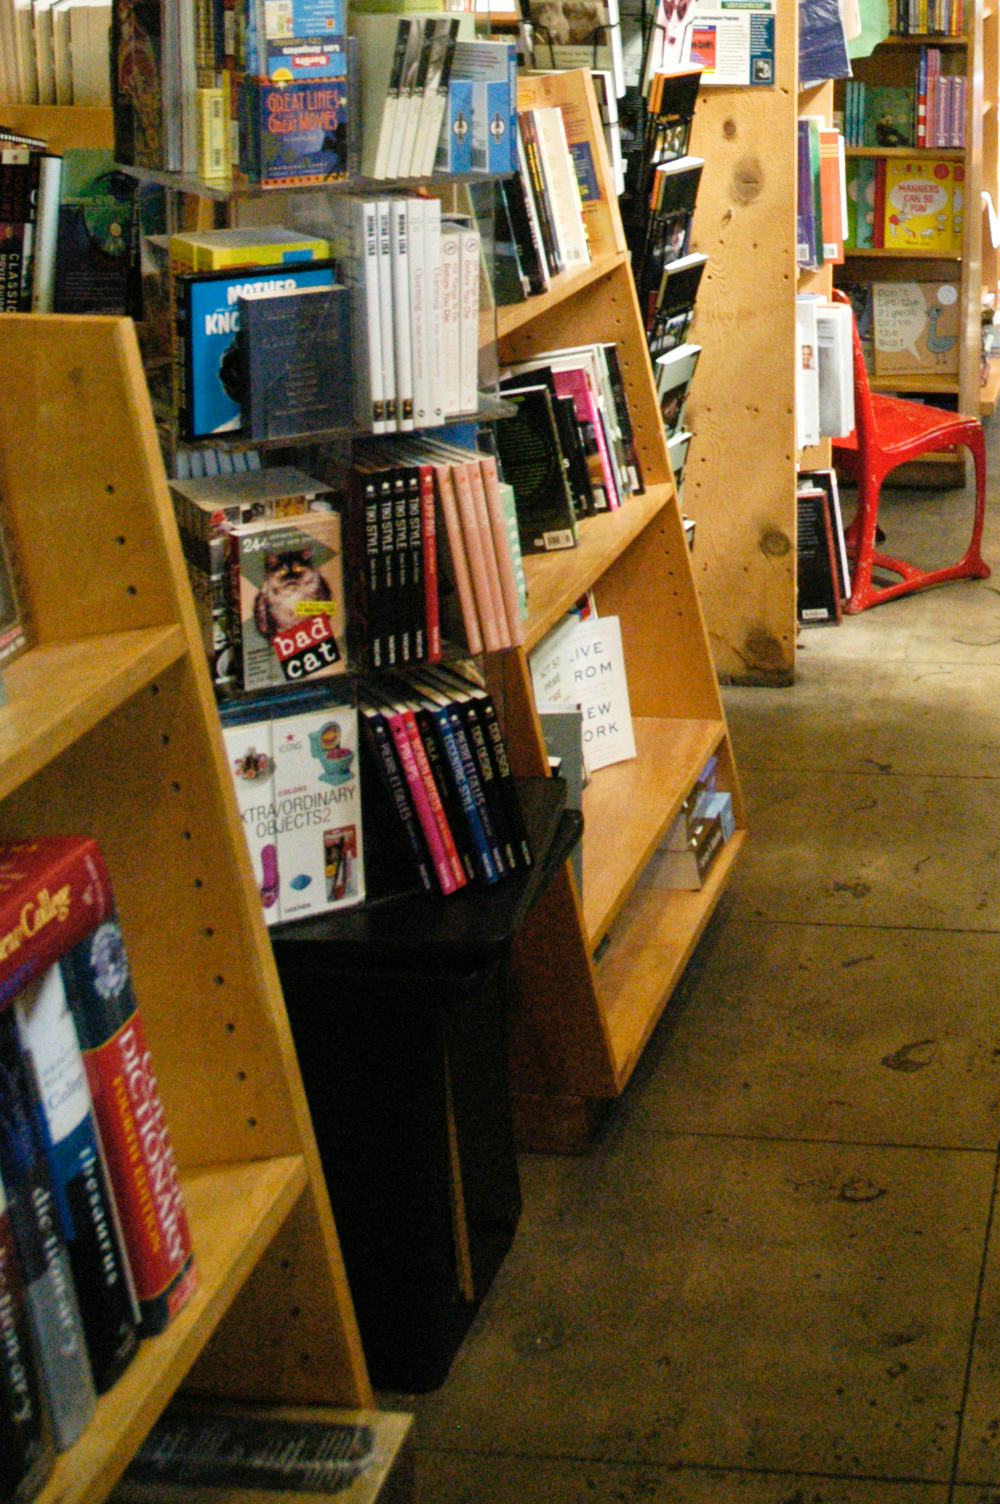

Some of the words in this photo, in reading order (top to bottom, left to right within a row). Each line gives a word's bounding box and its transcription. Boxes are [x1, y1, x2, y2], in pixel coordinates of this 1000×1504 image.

[898, 184, 940, 195] MANNERS
[903, 194, 921, 203] CAN
[923, 195, 934, 204] BE
[909, 203, 927, 213] FUN
[398, 214, 406, 236] MONA
[398, 239, 406, 255] LISA
[878, 298, 898, 307] Let
[878, 318, 911, 327] Drive
[879, 328, 899, 337] the
[367, 505, 376, 522] TIKI
[381, 502, 390, 520] TIKI
[395, 500, 404, 517] TIKI
[409, 497, 418, 515] TIKI
[367, 525, 377, 555] STYLE
[382, 523, 391, 552] STYLE
[396, 520, 405, 550] STYLE
[410, 518, 419, 548] STYLE
[274, 616, 329, 657] bad
[287, 642, 336, 678] cat
[457, 785, 473, 813] STYLE
[118, 1027, 184, 1262] DICTIONARY
[79, 1146, 118, 1286] thesaurus
